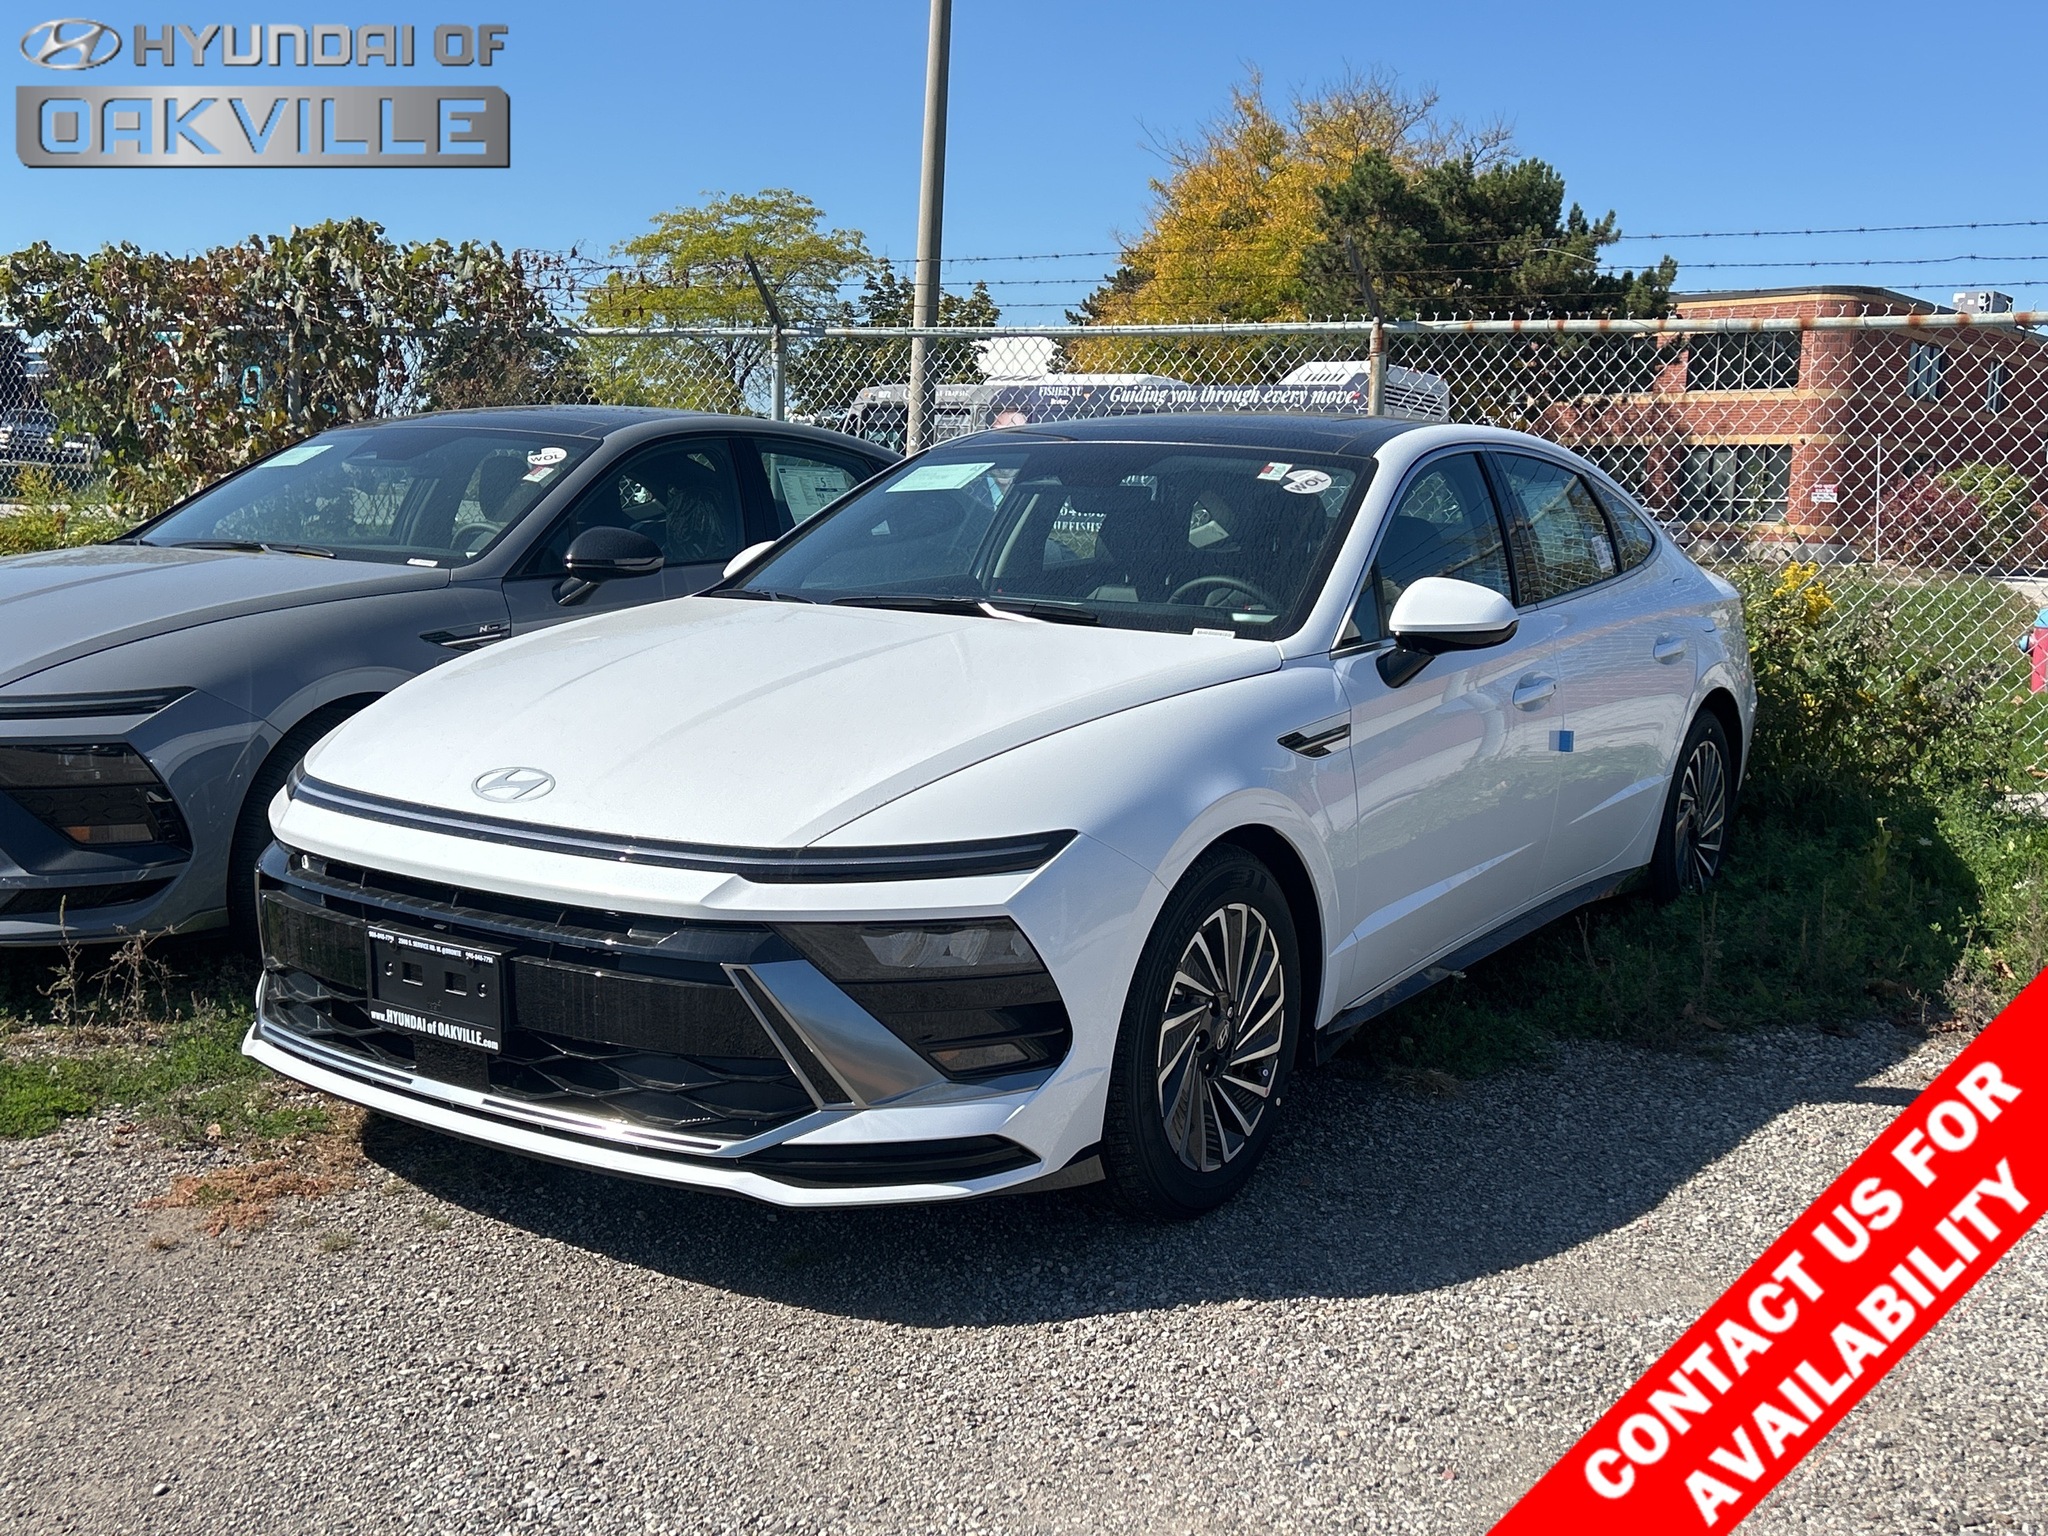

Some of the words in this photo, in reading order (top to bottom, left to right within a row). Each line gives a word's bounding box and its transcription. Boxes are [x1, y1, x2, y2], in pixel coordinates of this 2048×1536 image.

[1038, 386, 1070, 397] FISHER
[1109, 386, 1168, 406] Guiding
[1171, 388, 1196, 406] you
[1200, 385, 1259, 407] through
[1263, 388, 1307, 407] every
[530, 454, 562, 462] WOL
[1290, 477, 1328, 491] WOL
[370, 1009, 426, 1032] www.HYUNDAI
[427, 1021, 436, 1034] of
[437, 1021, 499, 1050] OAKVILLE.com
